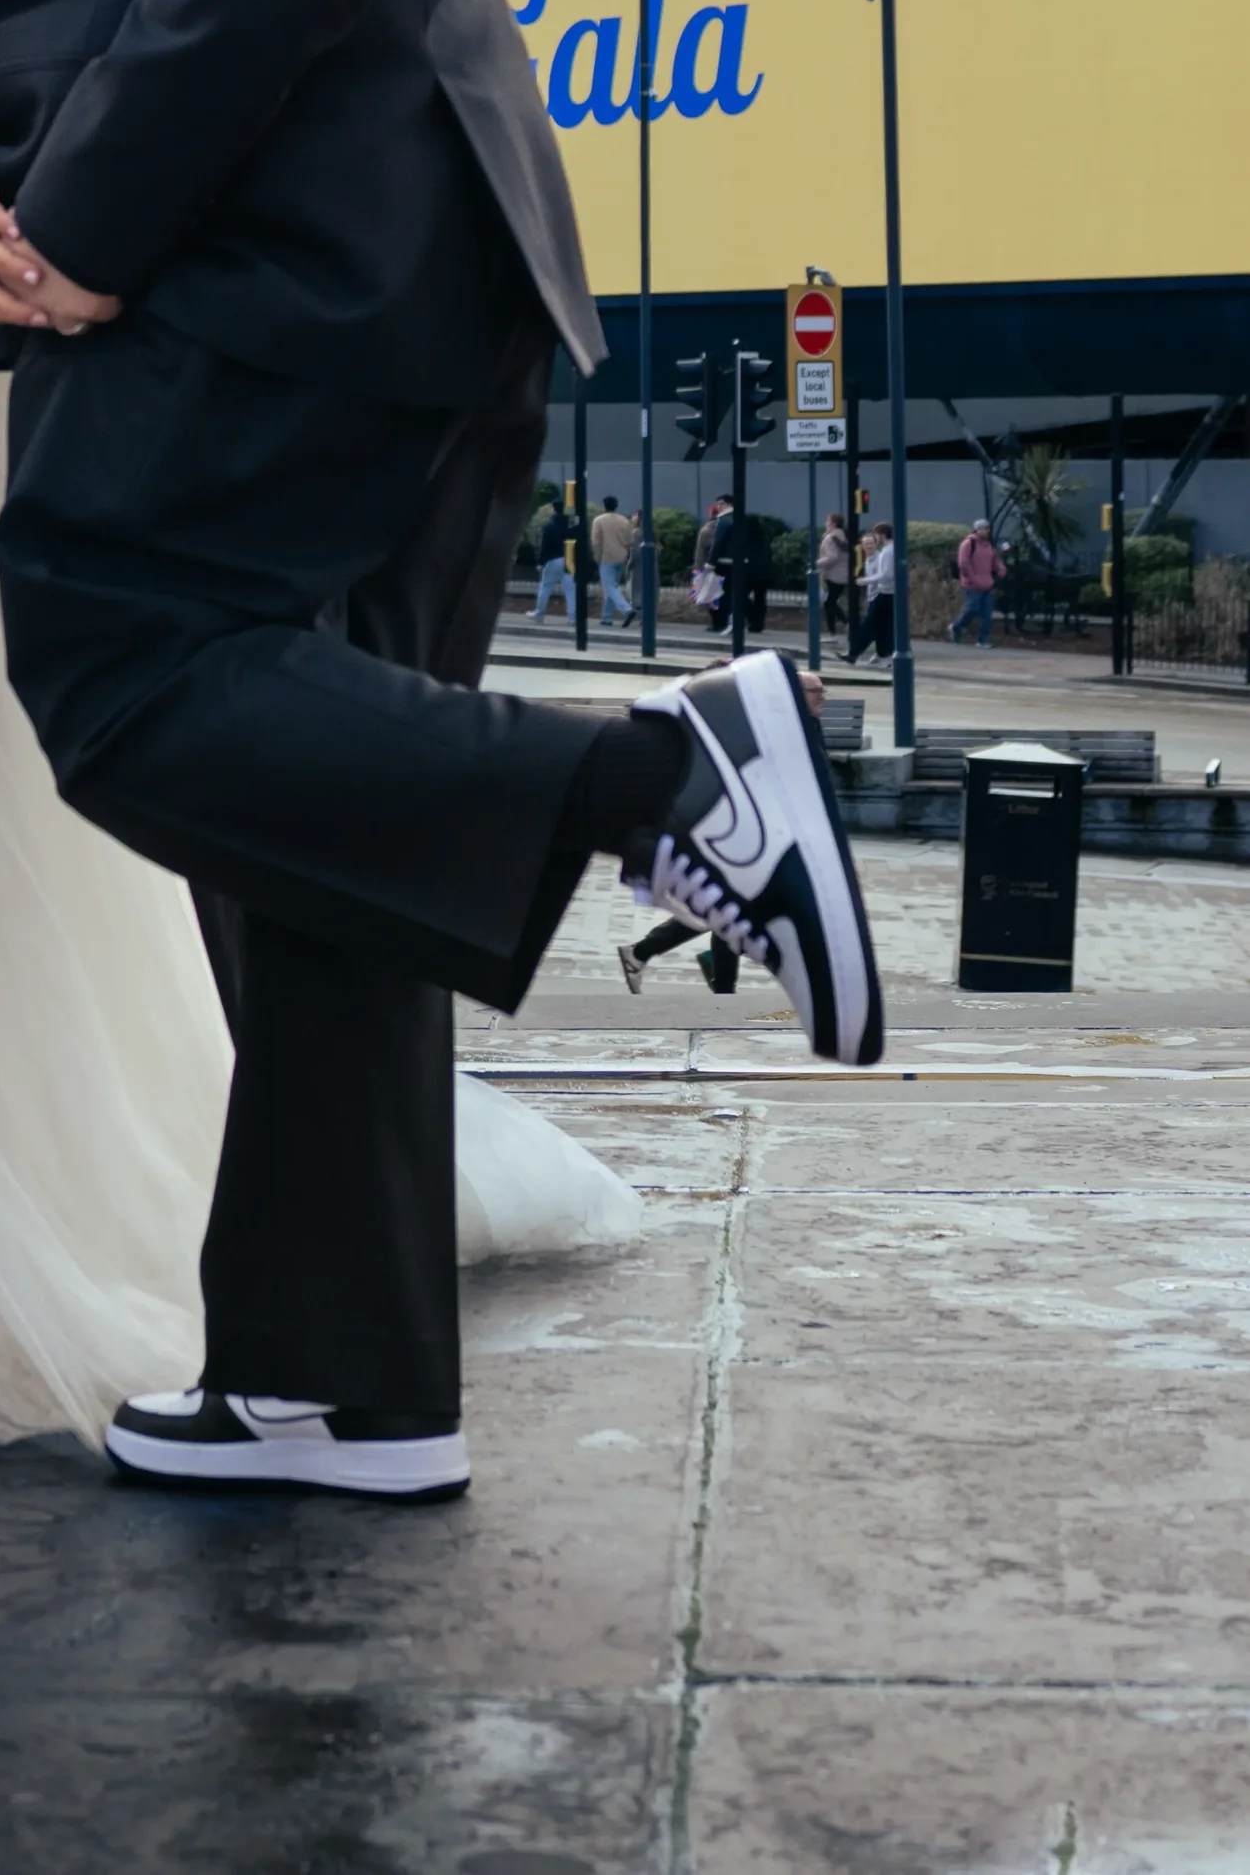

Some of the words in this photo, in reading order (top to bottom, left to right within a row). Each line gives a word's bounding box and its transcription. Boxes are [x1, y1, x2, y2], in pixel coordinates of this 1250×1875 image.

[800, 368, 830, 378] Except
[805, 381, 826, 391] local
[803, 395, 828, 405] buses
